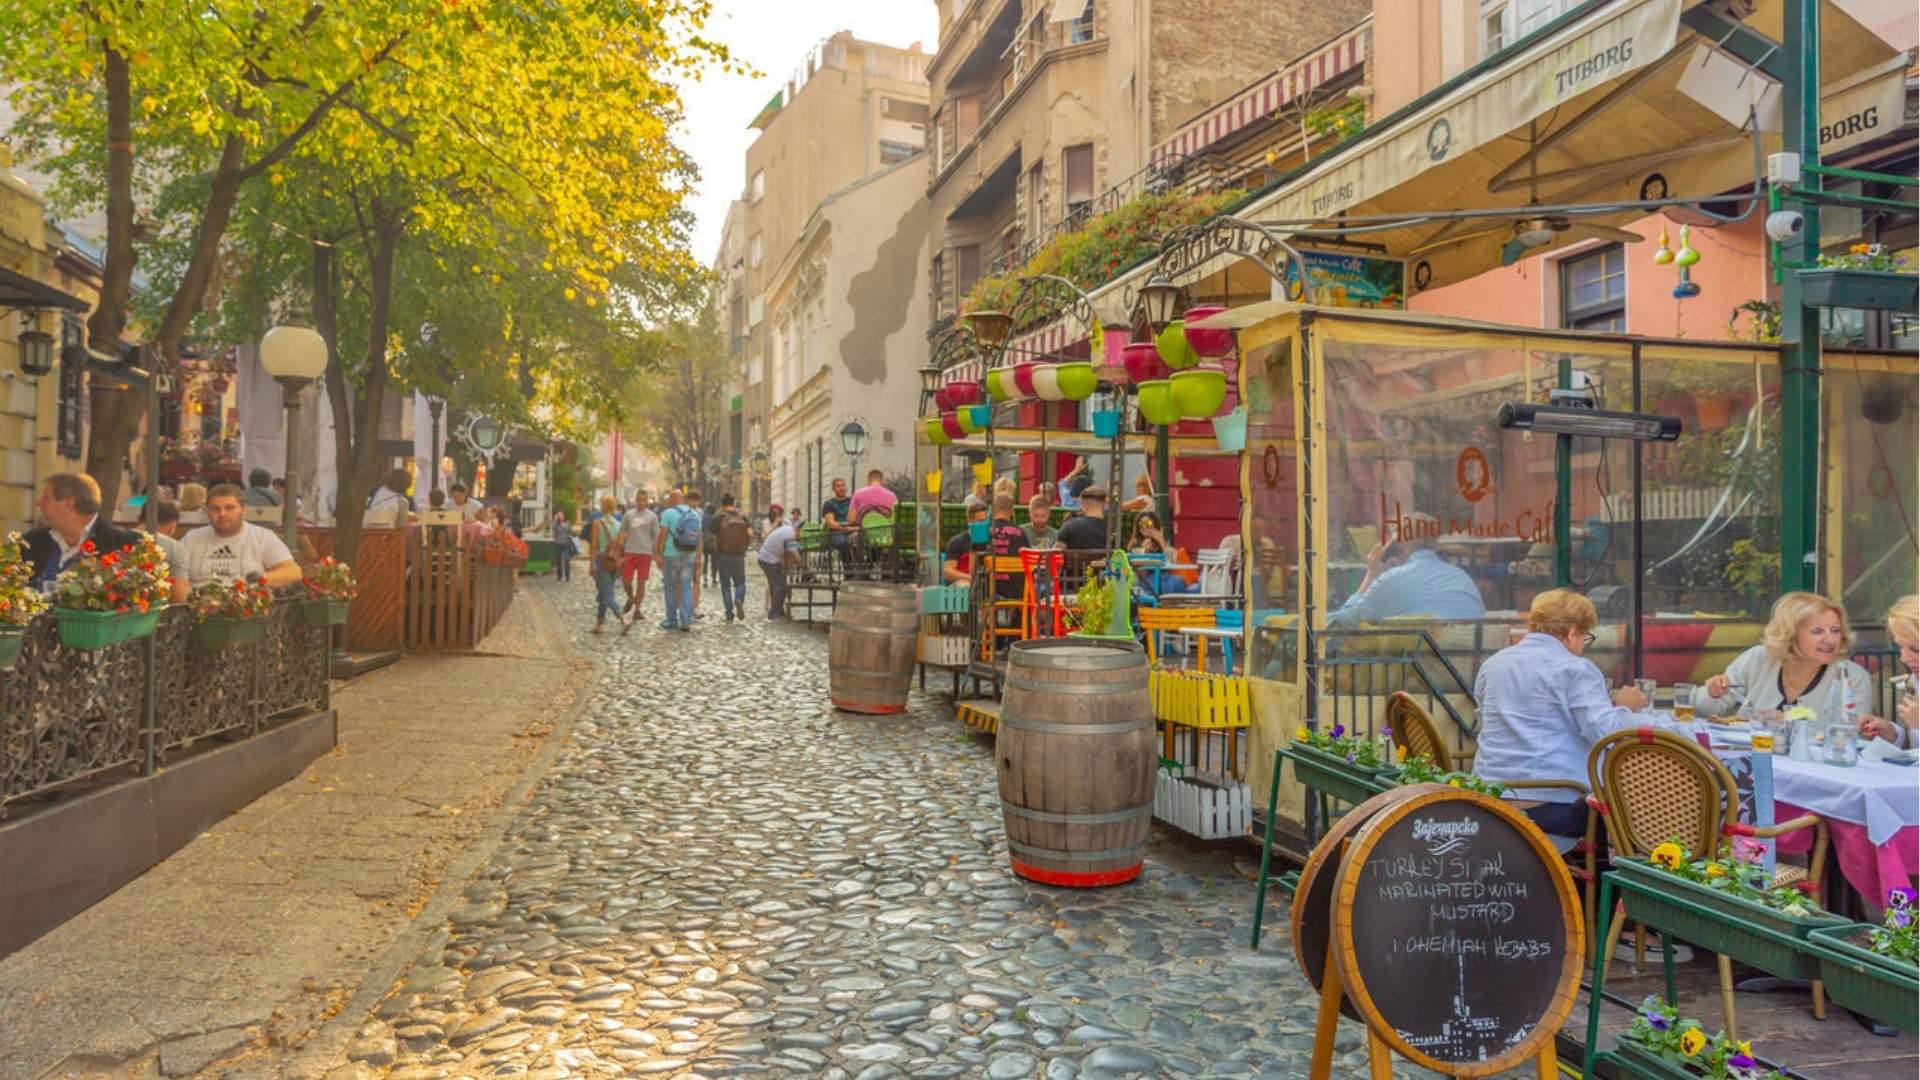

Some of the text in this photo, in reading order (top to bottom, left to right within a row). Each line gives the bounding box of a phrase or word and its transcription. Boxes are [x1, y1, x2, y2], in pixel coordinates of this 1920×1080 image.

[1555, 35, 1633, 94] TUBORG
[1820, 105, 1879, 145] BORG
[1380, 491, 1555, 546] Hand Made Caf
[1369, 854, 1445, 879] TURKEY
[1487, 881, 1528, 898] WITH
[1430, 901, 1515, 924] MUSTARD
[1494, 935, 1552, 959] KEBABS
